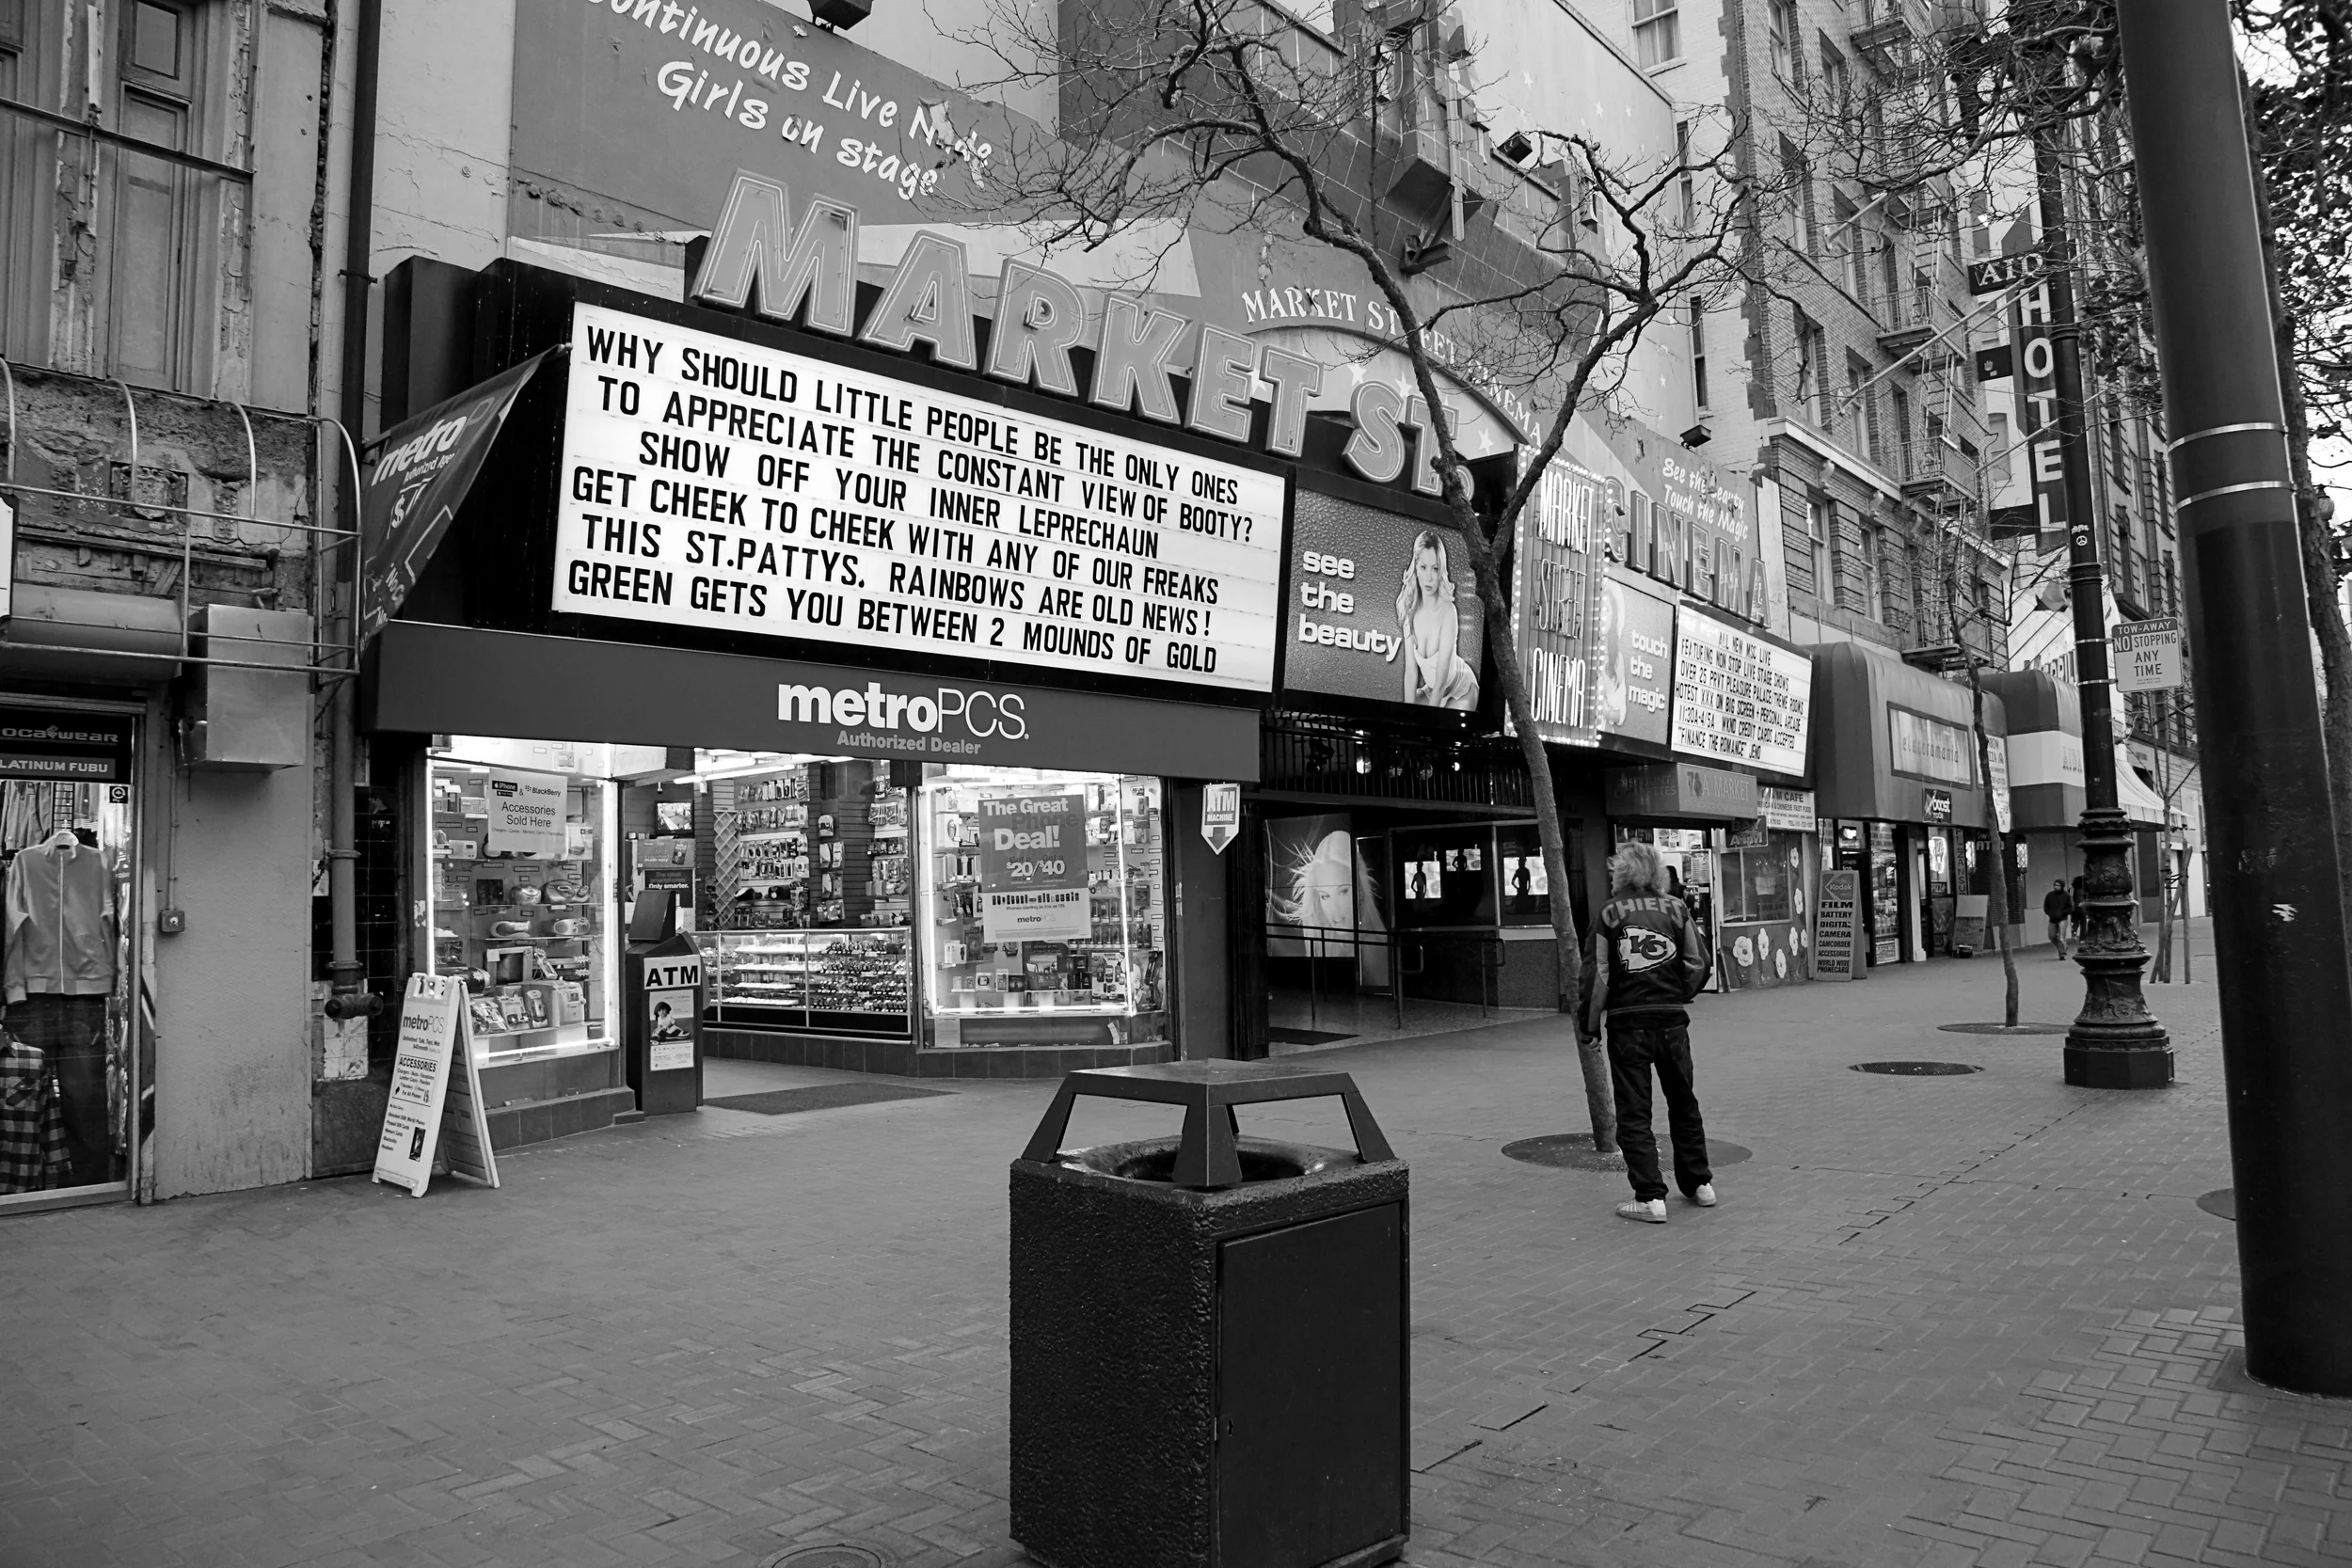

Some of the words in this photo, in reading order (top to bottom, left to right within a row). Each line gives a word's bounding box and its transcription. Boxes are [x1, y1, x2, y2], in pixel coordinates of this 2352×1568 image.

[587, 0, 809, 92] ontinuous
[821, 71, 898, 128] Live
[658, 60, 769, 131] Girls
[781, 112, 824, 153] on
[836, 135, 938, 200] stage
[690, 168, 1324, 457] MARKET
[1242, 285, 1357, 323] MARKET
[1368, 301, 1457, 365] STEET
[587, 325, 664, 374] WHY
[681, 347, 797, 404] SHOULD
[816, 380, 912, 431] LITTLE
[927, 406, 1018, 455] PEOPLE
[1034, 431, 1062, 466] BE
[1075, 441, 1115, 477] THE
[1125, 453, 1179, 491] ONLY
[1191, 470, 1238, 505] ONES
[2019, 282, 2068, 533] HOTEL
[597, 375, 640, 416] TO
[662, 391, 854, 458] APPRECIATE
[872, 435, 920, 473] THE
[938, 449, 1064, 503] CONSTANT
[1082, 480, 1136, 518] VIEW
[1143, 494, 1168, 524] OF
[1180, 502, 1253, 543] BOOTY?
[1662, 457, 1685, 483] See
[1690, 471, 1706, 494] the
[639, 431, 730, 478] SHOW
[756, 454, 810, 493] OFF
[835, 467, 906, 512] YOUR
[930, 487, 1000, 529] INNER
[1019, 505, 1158, 560] LEPRECHAUN
[1537, 468, 1594, 555] MARKET
[1664, 484, 1694, 516] Touch
[1697, 501, 1715, 525] the
[1718, 511, 1748, 542] Magic
[573, 466, 636, 508] GET
[650, 480, 748, 527] CHEEK
[762, 498, 797, 533] TO
[810, 507, 896, 551] CHEEK
[909, 523, 973, 563] WITH
[987, 539, 1039, 575] ANY
[1053, 550, 1079, 580] OF
[1092, 557, 1133, 590] OUR
[1143, 566, 1218, 605] FREAKS
[1302, 550, 1355, 579] see
[1603, 474, 1772, 629] CINEMA
[581, 514, 660, 558] THIS
[889, 562, 1025, 610] RAINBOWS
[1038, 585, 1083, 619] ARE
[1092, 594, 1133, 626] OLD
[1142, 601, 1211, 637] NEWS!
[1300, 581, 1354, 614] the
[568, 559, 673, 606] GREEN
[690, 576, 767, 617] GETS
[787, 587, 843, 627] YOU
[857, 598, 977, 643] BETWEEN
[990, 617, 1005, 646] 2
[1023, 622, 1114, 660] MOUNDS
[1125, 635, 1151, 665] OF
[1167, 642, 1216, 673] GOLD
[2118, 621, 2171, 635] TOW-AWAY
[1298, 613, 1402, 662] beauty
[1631, 629, 1668, 659] touch
[1733, 636, 1743, 655] NEW
[1759, 648, 1772, 666] LIVE
[2116, 636, 2131, 652] NO
[2134, 632, 2176, 648] STOPPING
[1629, 655, 1653, 680] the
[1716, 651, 1726, 669] NON
[1728, 656, 1741, 674] STOP
[1743, 661, 1756, 680] LIVE
[1757, 667, 1772, 687] STAGE
[1774, 673, 1788, 691] SHOWS
[2134, 663, 2163, 677] TIME
[2135, 650, 2159, 664] ANY
[1531, 647, 1585, 729] CINEMA
[1629, 685, 1665, 713] magic
[1680, 660, 1696, 680] OVER
[1699, 667, 1707, 684] 25
[1709, 671, 1724, 690] PRVT
[1726, 676, 1752, 699] PLEASURE
[1789, 696, 1804, 715] ROOMS
[1676, 680, 1698, 703] HOTEST
[1701, 689, 1714, 708] XXX
[1716, 693, 1723, 710] ON
[1725, 696, 1736, 713] BIG
[1737, 700, 1756, 720] SCREEN
[1760, 706, 1783, 727] PERSONAL
[837, 730, 927, 752] Authorized
[930, 736, 981, 755] Dealer
[1708, 734, 1719, 752] THE
[1739, 721, 1756, 738] CREDIT
[1757, 726, 1772, 743] CARDS
[1773, 730, 1795, 750] ACCEPTED
[70, 762, 108, 773] FUBU
[532, 786, 562, 797] BlackBerry
[1207, 788, 1235, 812] ATM
[1714, 775, 1750, 801] MARKET
[1784, 792, 1804, 802] CAFE
[501, 801, 556, 816] Accessories
[506, 815, 527, 826] Sold
[530, 816, 551, 827] Here
[983, 800, 1017, 816] The
[1020, 798, 1069, 815] Great
[1010, 812, 1079, 830] Phone
[1207, 814, 1233, 822] MACHINE
[993, 825, 1060, 850] Deal!
[1730, 832, 1763, 846] ATM
[1007, 860, 1066, 877] $20/$40
[1017, 913, 1056, 924] metroPCS
[1602, 897, 1685, 928] CHIEFS
[1629, 935, 1667, 959] KC
[1818, 949, 1851, 958] ACCESSORIES
[645, 965, 698, 988] ATM
[403, 1014, 445, 1034] metroPCS
[399, 1056, 437, 1072] ACCESSORIES
